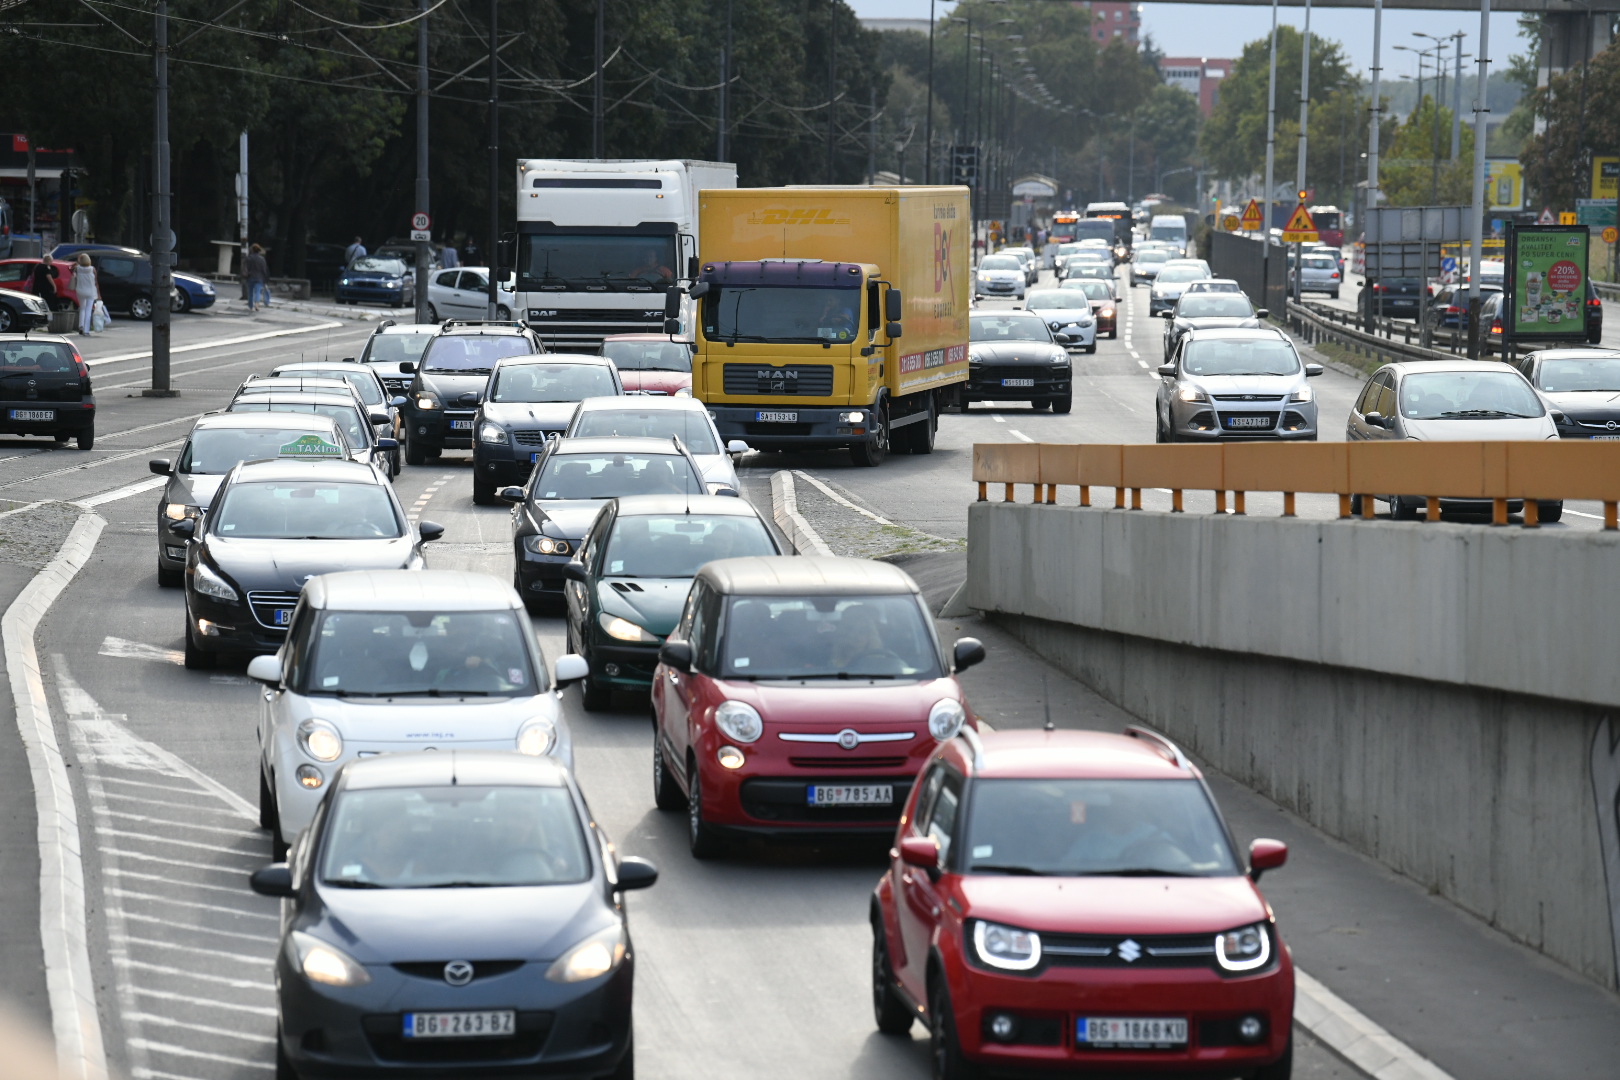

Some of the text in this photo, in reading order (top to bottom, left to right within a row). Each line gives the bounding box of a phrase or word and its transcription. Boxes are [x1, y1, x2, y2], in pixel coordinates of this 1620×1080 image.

[761, 208, 836, 224] DHL
[415, 216, 427, 226] 20
[1604, 230, 1615, 241] 30
[1554, 266, 1575, 275] -20%
[757, 370, 798, 379] MAN
[760, 413, 769, 421] SA
[455, 421, 464, 429] PA
[1232, 418, 1241, 426] NS
[297, 444, 325, 453] TAXI
[817, 787, 834, 802] BG
[416, 1015, 438, 1034] BG
[1089, 1021, 1108, 1040] BG
